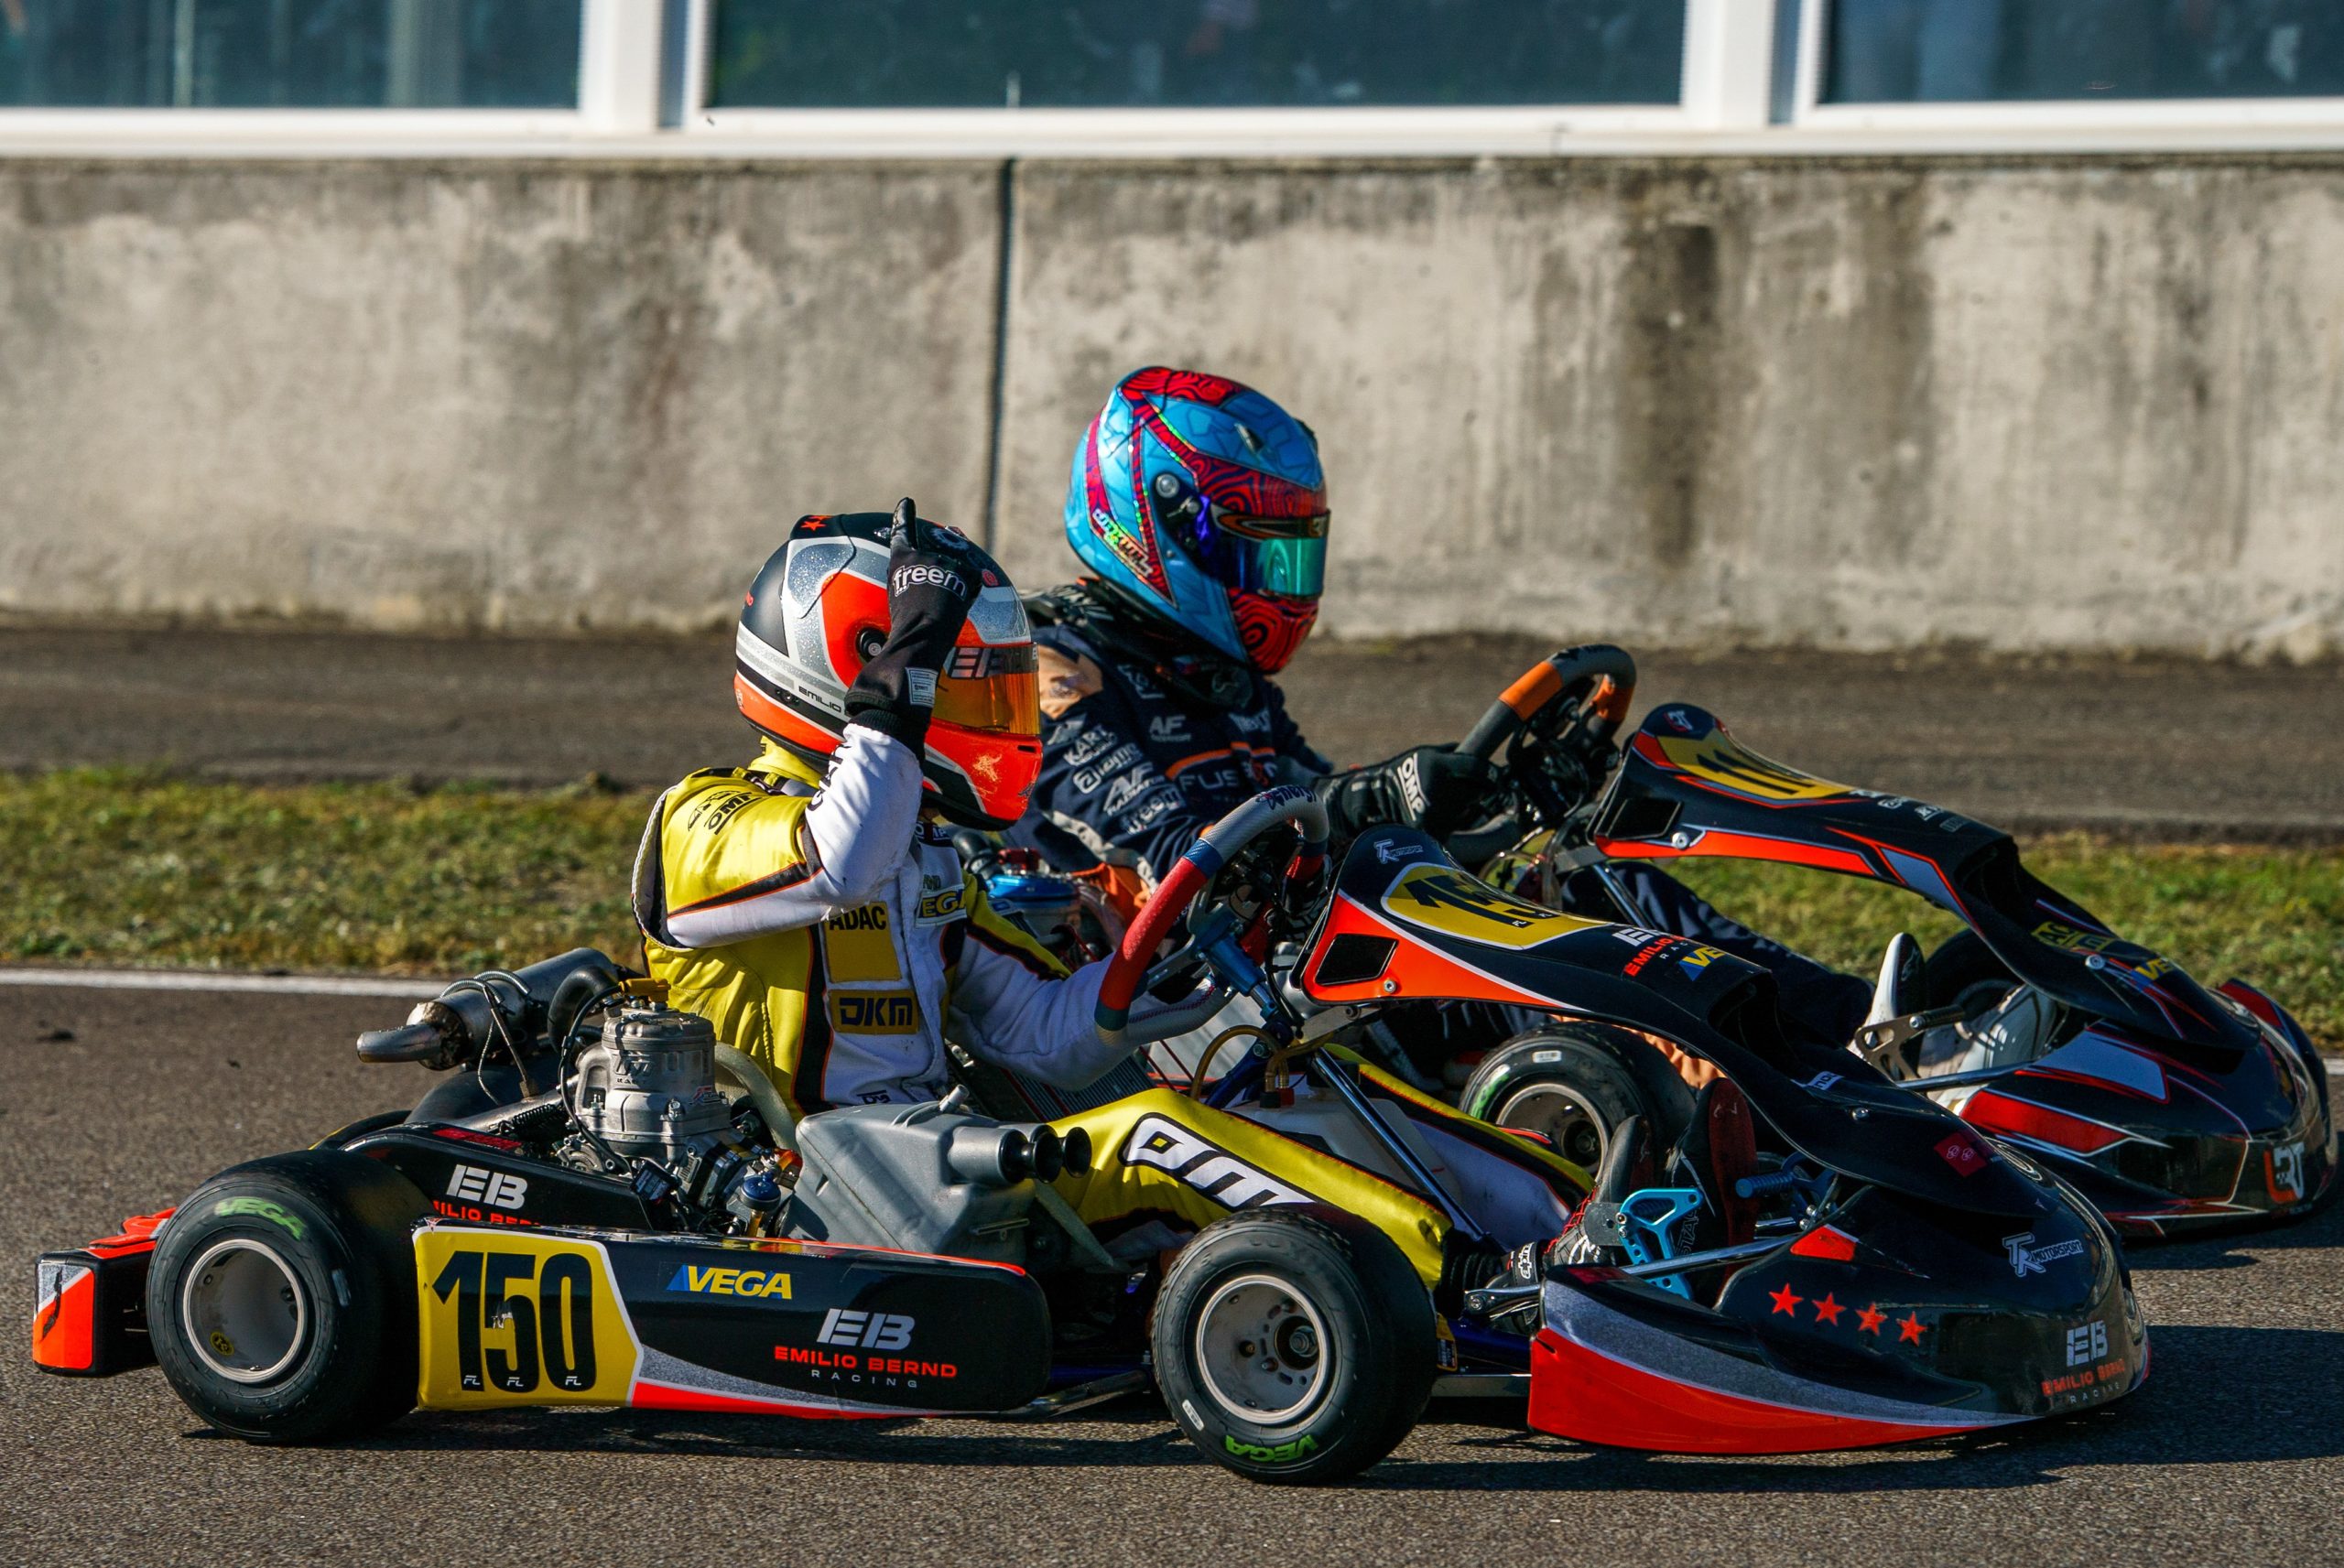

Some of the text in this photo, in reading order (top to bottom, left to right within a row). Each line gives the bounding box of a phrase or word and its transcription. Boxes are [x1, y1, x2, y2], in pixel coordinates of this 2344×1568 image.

[798, 685, 842, 714] EMILIO
[1401, 756, 1427, 814] OMP
[840, 997, 912, 1026] DKM
[446, 1163, 528, 1210] EB
[2032, 1239, 2084, 1264] MOTORSPORT
[688, 1265, 793, 1301] VEGA
[432, 1250, 597, 1393] 150
[816, 1308, 916, 1351] EB
[2066, 1319, 2110, 1368] EB
[774, 1346, 957, 1379] EMILIO BERND
[811, 1369, 917, 1390] RACING
[2040, 1369, 2095, 1397] EMILIO
[1225, 1433, 1319, 1463] VEGA
